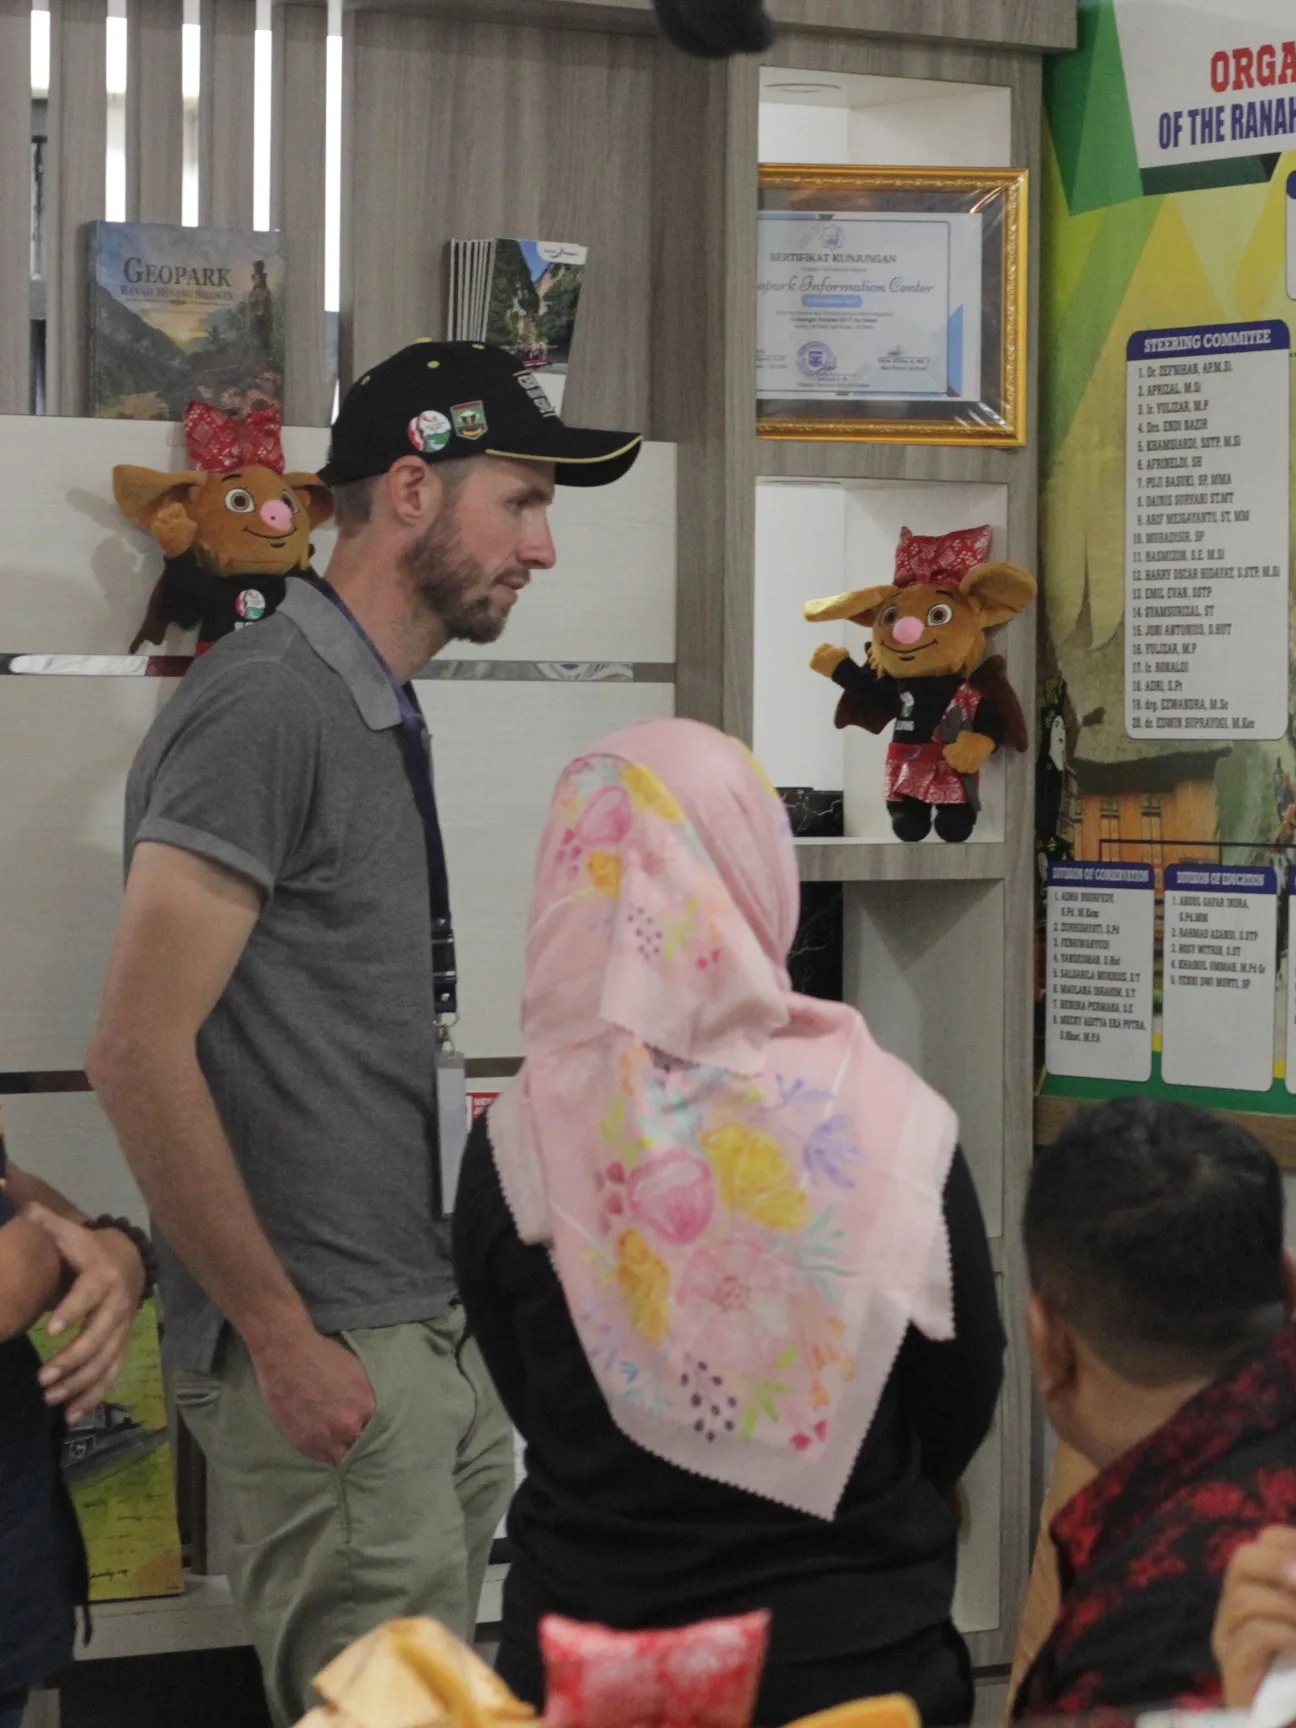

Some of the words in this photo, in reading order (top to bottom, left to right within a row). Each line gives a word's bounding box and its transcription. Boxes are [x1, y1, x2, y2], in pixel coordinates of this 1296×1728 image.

[1158, 110, 1184, 149] OF
[1187, 105, 1225, 145] THE
[769, 252, 831, 264] SERTIFIKAT
[832, 253, 897, 265] KUNJUNGAN
[123, 256, 233, 289] GEOPARK
[798, 274, 886, 294] Information
[888, 276, 935, 293] Center
[1143, 335, 1201, 354] STEERING
